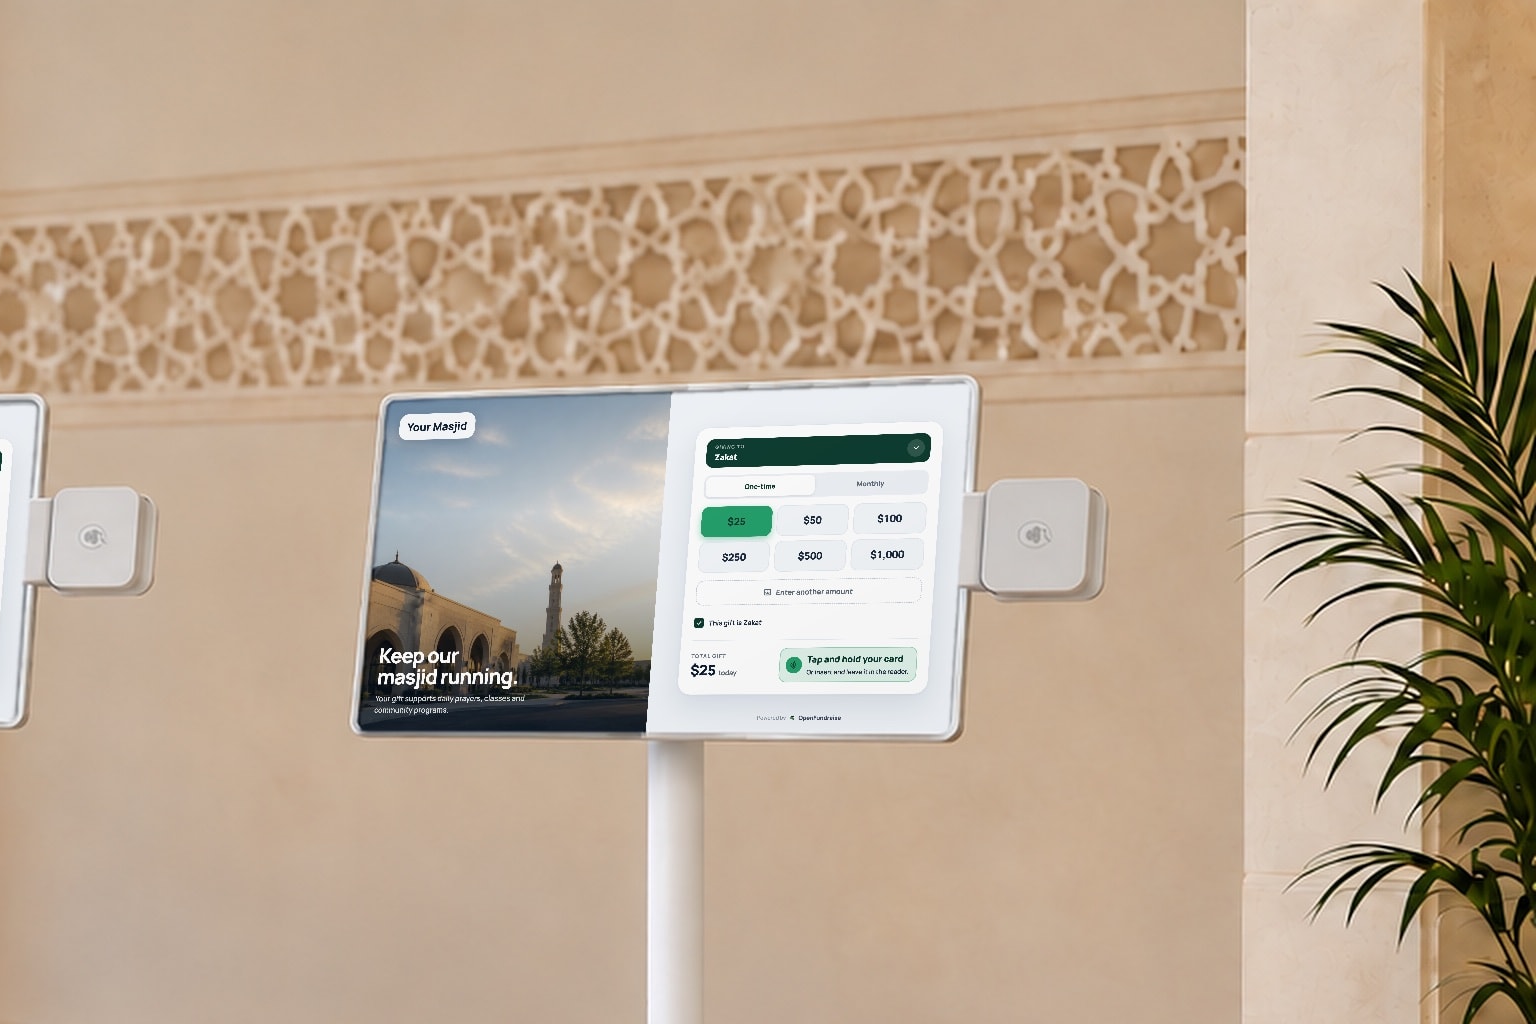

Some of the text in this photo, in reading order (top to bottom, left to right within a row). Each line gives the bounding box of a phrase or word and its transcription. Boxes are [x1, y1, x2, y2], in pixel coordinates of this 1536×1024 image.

[407, 421, 468, 433] Your Masjid
[714, 453, 738, 461] Zakat
[856, 480, 885, 488] Monthly
[727, 517, 746, 527] $25
[803, 515, 823, 526] $50
[877, 514, 903, 524] $100
[721, 552, 747, 563] $250
[797, 551, 823, 561] $500
[870, 550, 905, 560] $1,000
[795, 588, 825, 596] another
[379, 647, 460, 669] Keep our
[807, 655, 823, 665] Tap
[823, 655, 841, 663] and
[841, 655, 862, 663] hold
[883, 655, 904, 663] card
[690, 663, 716, 677] $25
[377, 667, 518, 690] masjid running.
[404, 695, 437, 703] supports
[373, 706, 449, 715] community programs.
